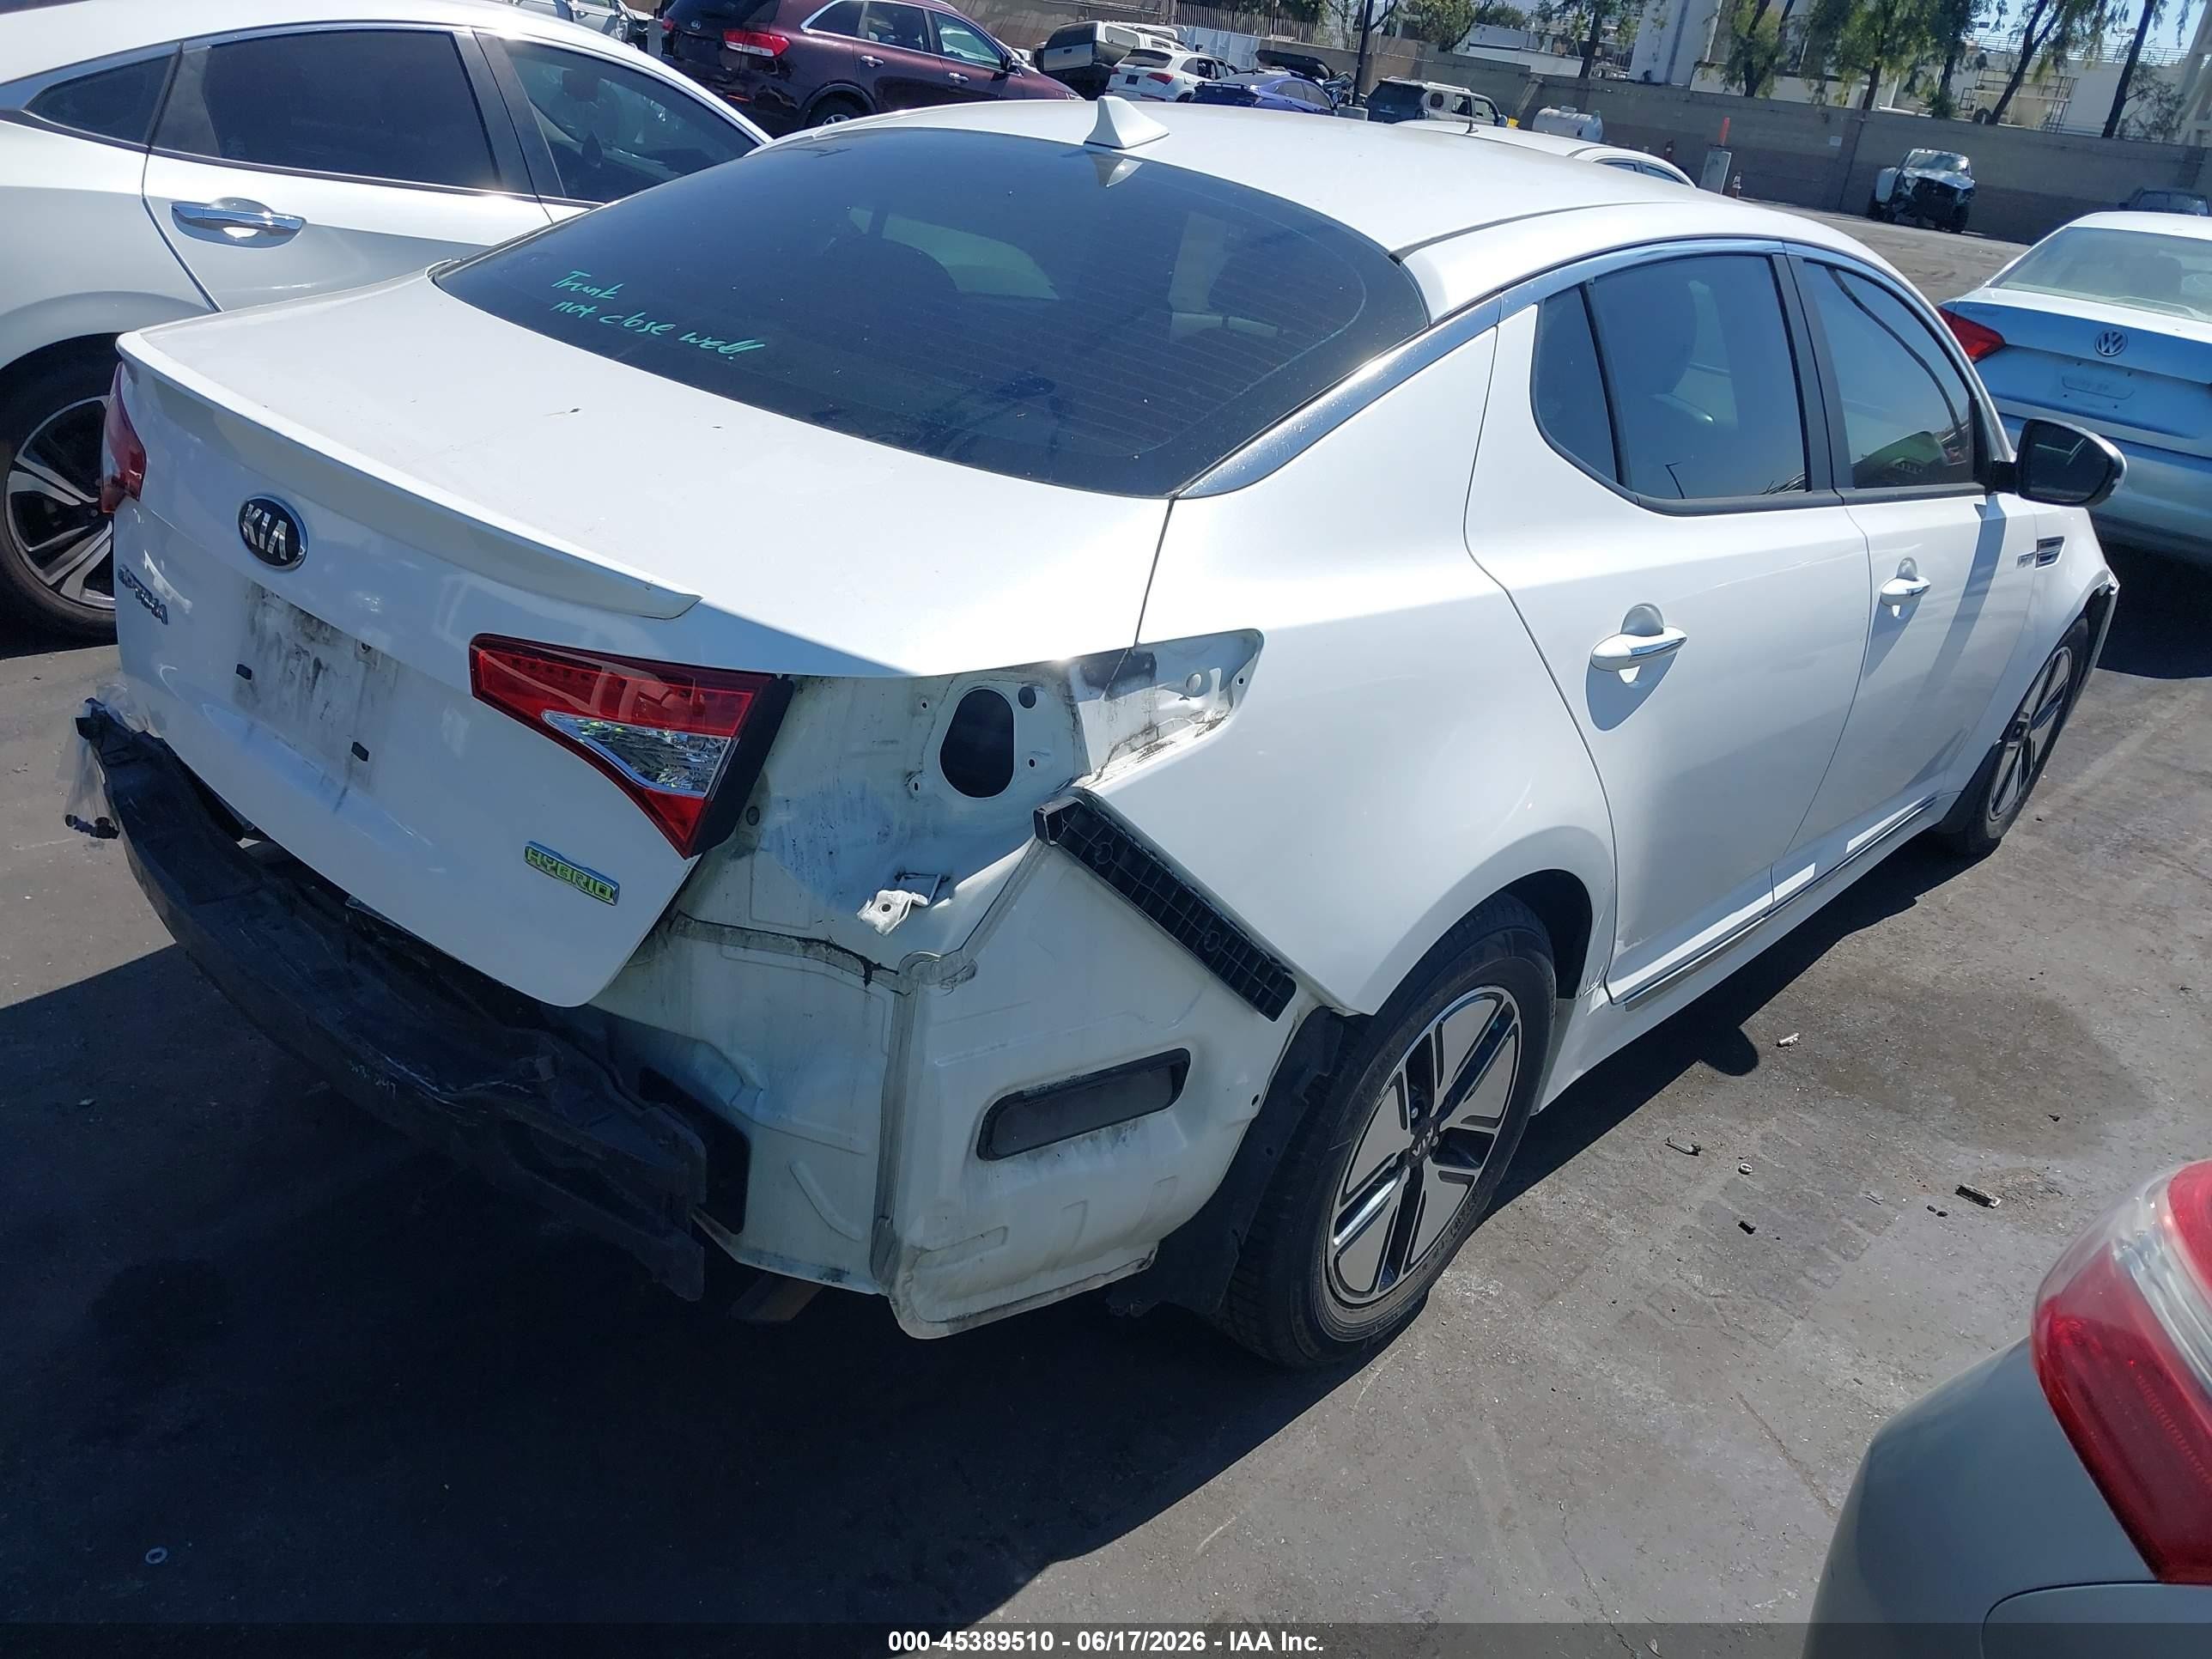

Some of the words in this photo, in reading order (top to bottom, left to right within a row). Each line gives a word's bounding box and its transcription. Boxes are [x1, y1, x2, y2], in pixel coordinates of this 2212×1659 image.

[550, 269, 624, 301] Trunk
[550, 301, 599, 319] not
[599, 312, 677, 336] close
[240, 502, 289, 561] KIA
[526, 848, 611, 901] HYBRID
